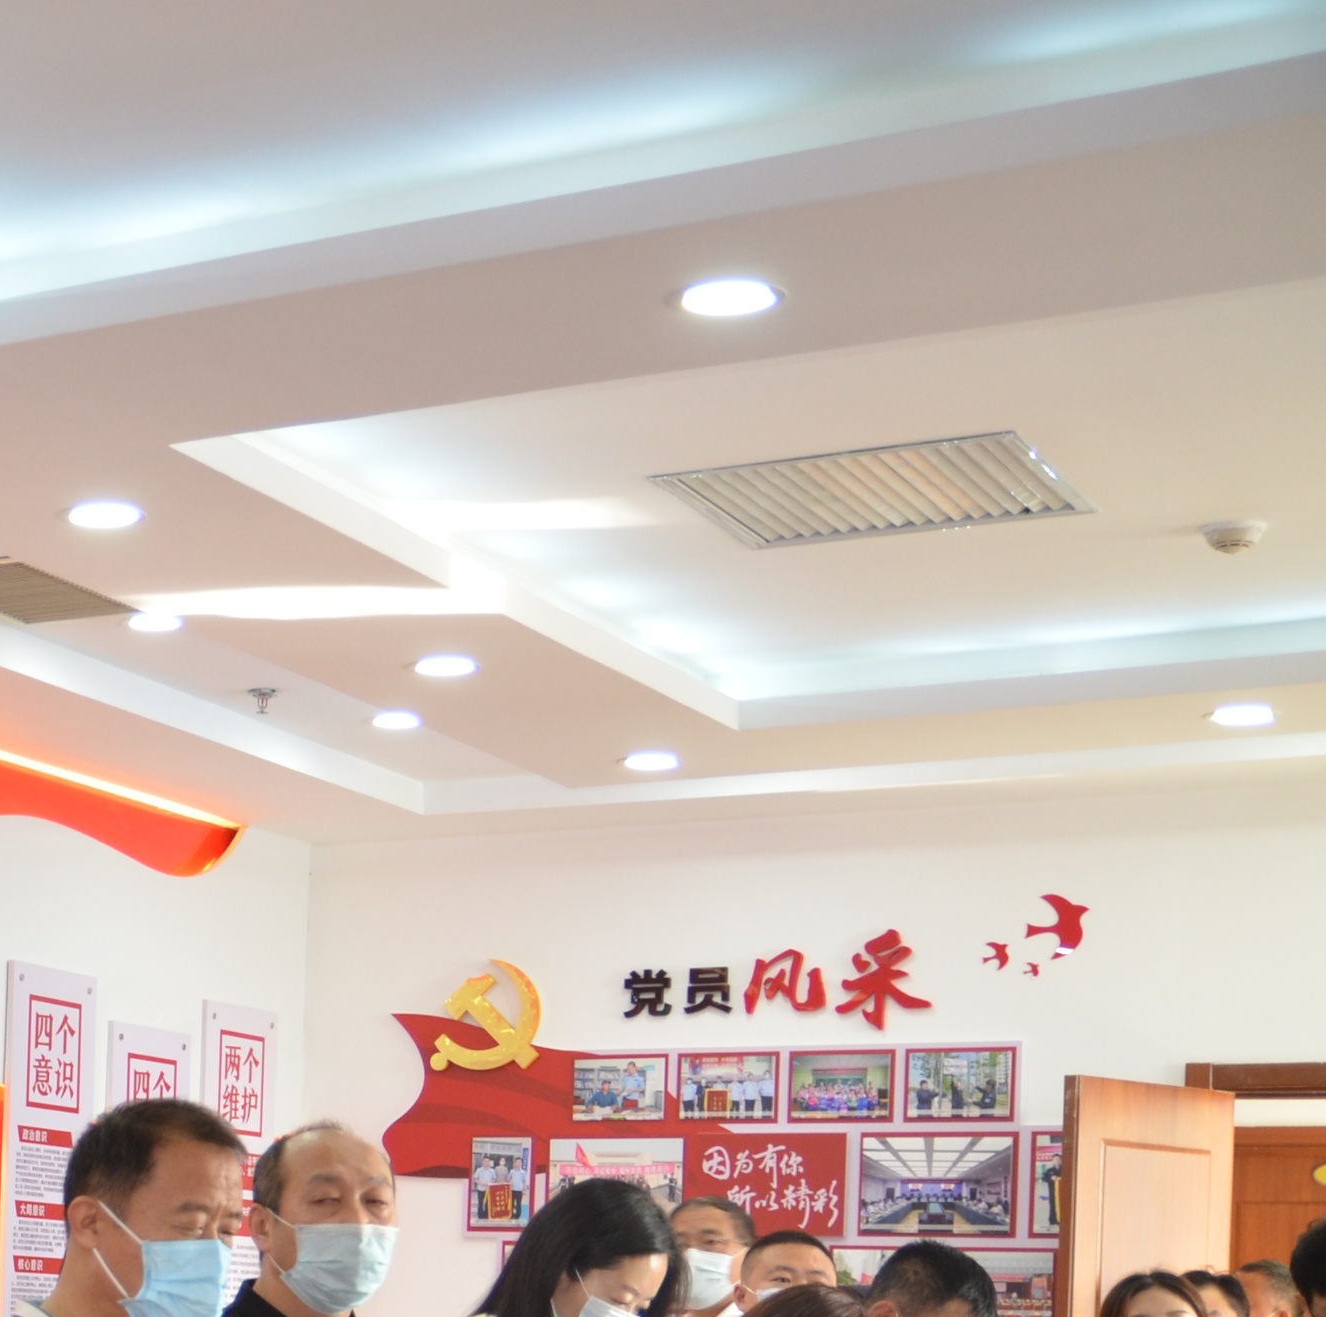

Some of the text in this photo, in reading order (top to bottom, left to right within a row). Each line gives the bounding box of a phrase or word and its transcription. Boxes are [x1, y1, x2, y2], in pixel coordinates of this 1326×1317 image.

[623, 928, 933, 1030] 党员风采
[35, 1011, 76, 1055] 四个
[32, 1055, 75, 1100] 意识
[224, 1044, 260, 1083] 两个
[133, 1069, 171, 1100] 四个
[222, 1083, 259, 1124] 维护
[22, 1128, 48, 1143] 政治意识
[702, 1144, 804, 1189] 因为有你
[19, 1203, 46, 1217] 大局意识
[727, 1178, 839, 1229] 所以精彩
[17, 1258, 44, 1272] 核心意识
